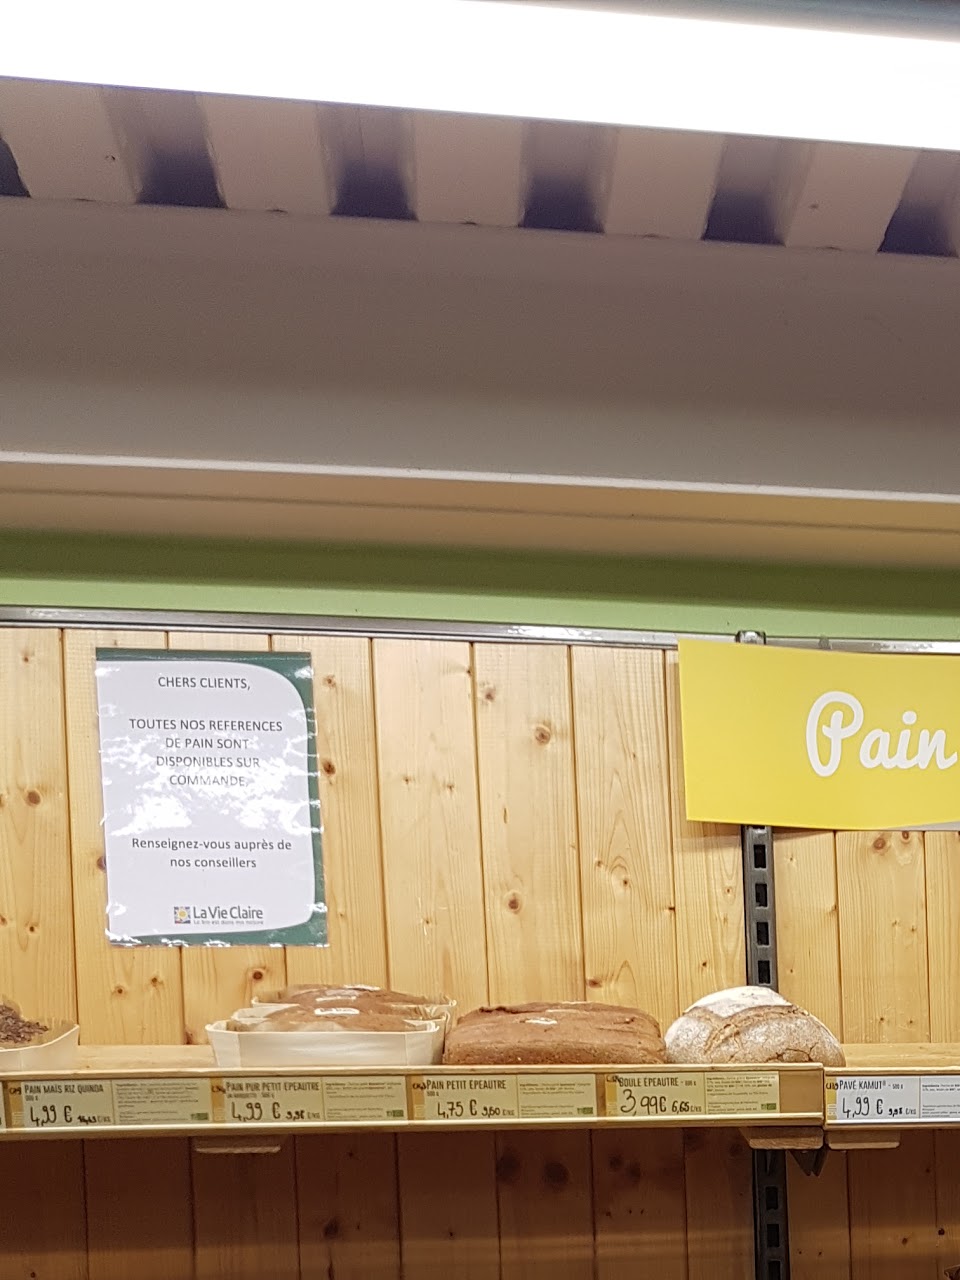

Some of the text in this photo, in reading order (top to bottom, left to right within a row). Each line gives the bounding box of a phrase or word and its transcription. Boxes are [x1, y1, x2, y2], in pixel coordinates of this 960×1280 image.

[158, 676, 250, 690] CHERS CLIENTS,
[129, 718, 283, 732] TOUTES NOS REFERENCES
[806, 691, 958, 778] Pain
[165, 737, 249, 749] DE PAIN SONT
[156, 755, 260, 768] DISPONIBLES SUR
[132, 837, 292, 852] Renseignez-vous auprès de
[170, 856, 257, 869] nos conseillers
[230, 905, 263, 919] Claire
[24, 1084, 41, 1093] PAIN
[226, 1082, 243, 1091] PAIN
[262, 1082, 281, 1091] PETIT
[426, 1080, 444, 1090] PAIN
[447, 1080, 466, 1090] PETIT
[619, 1077, 641, 1087] BOULE
[232, 1101, 262, 1121] 4,99
[437, 1101, 464, 1119] 4,75
[842, 1096, 870, 1118] 4,99
[30, 1104, 57, 1126] 4,99
